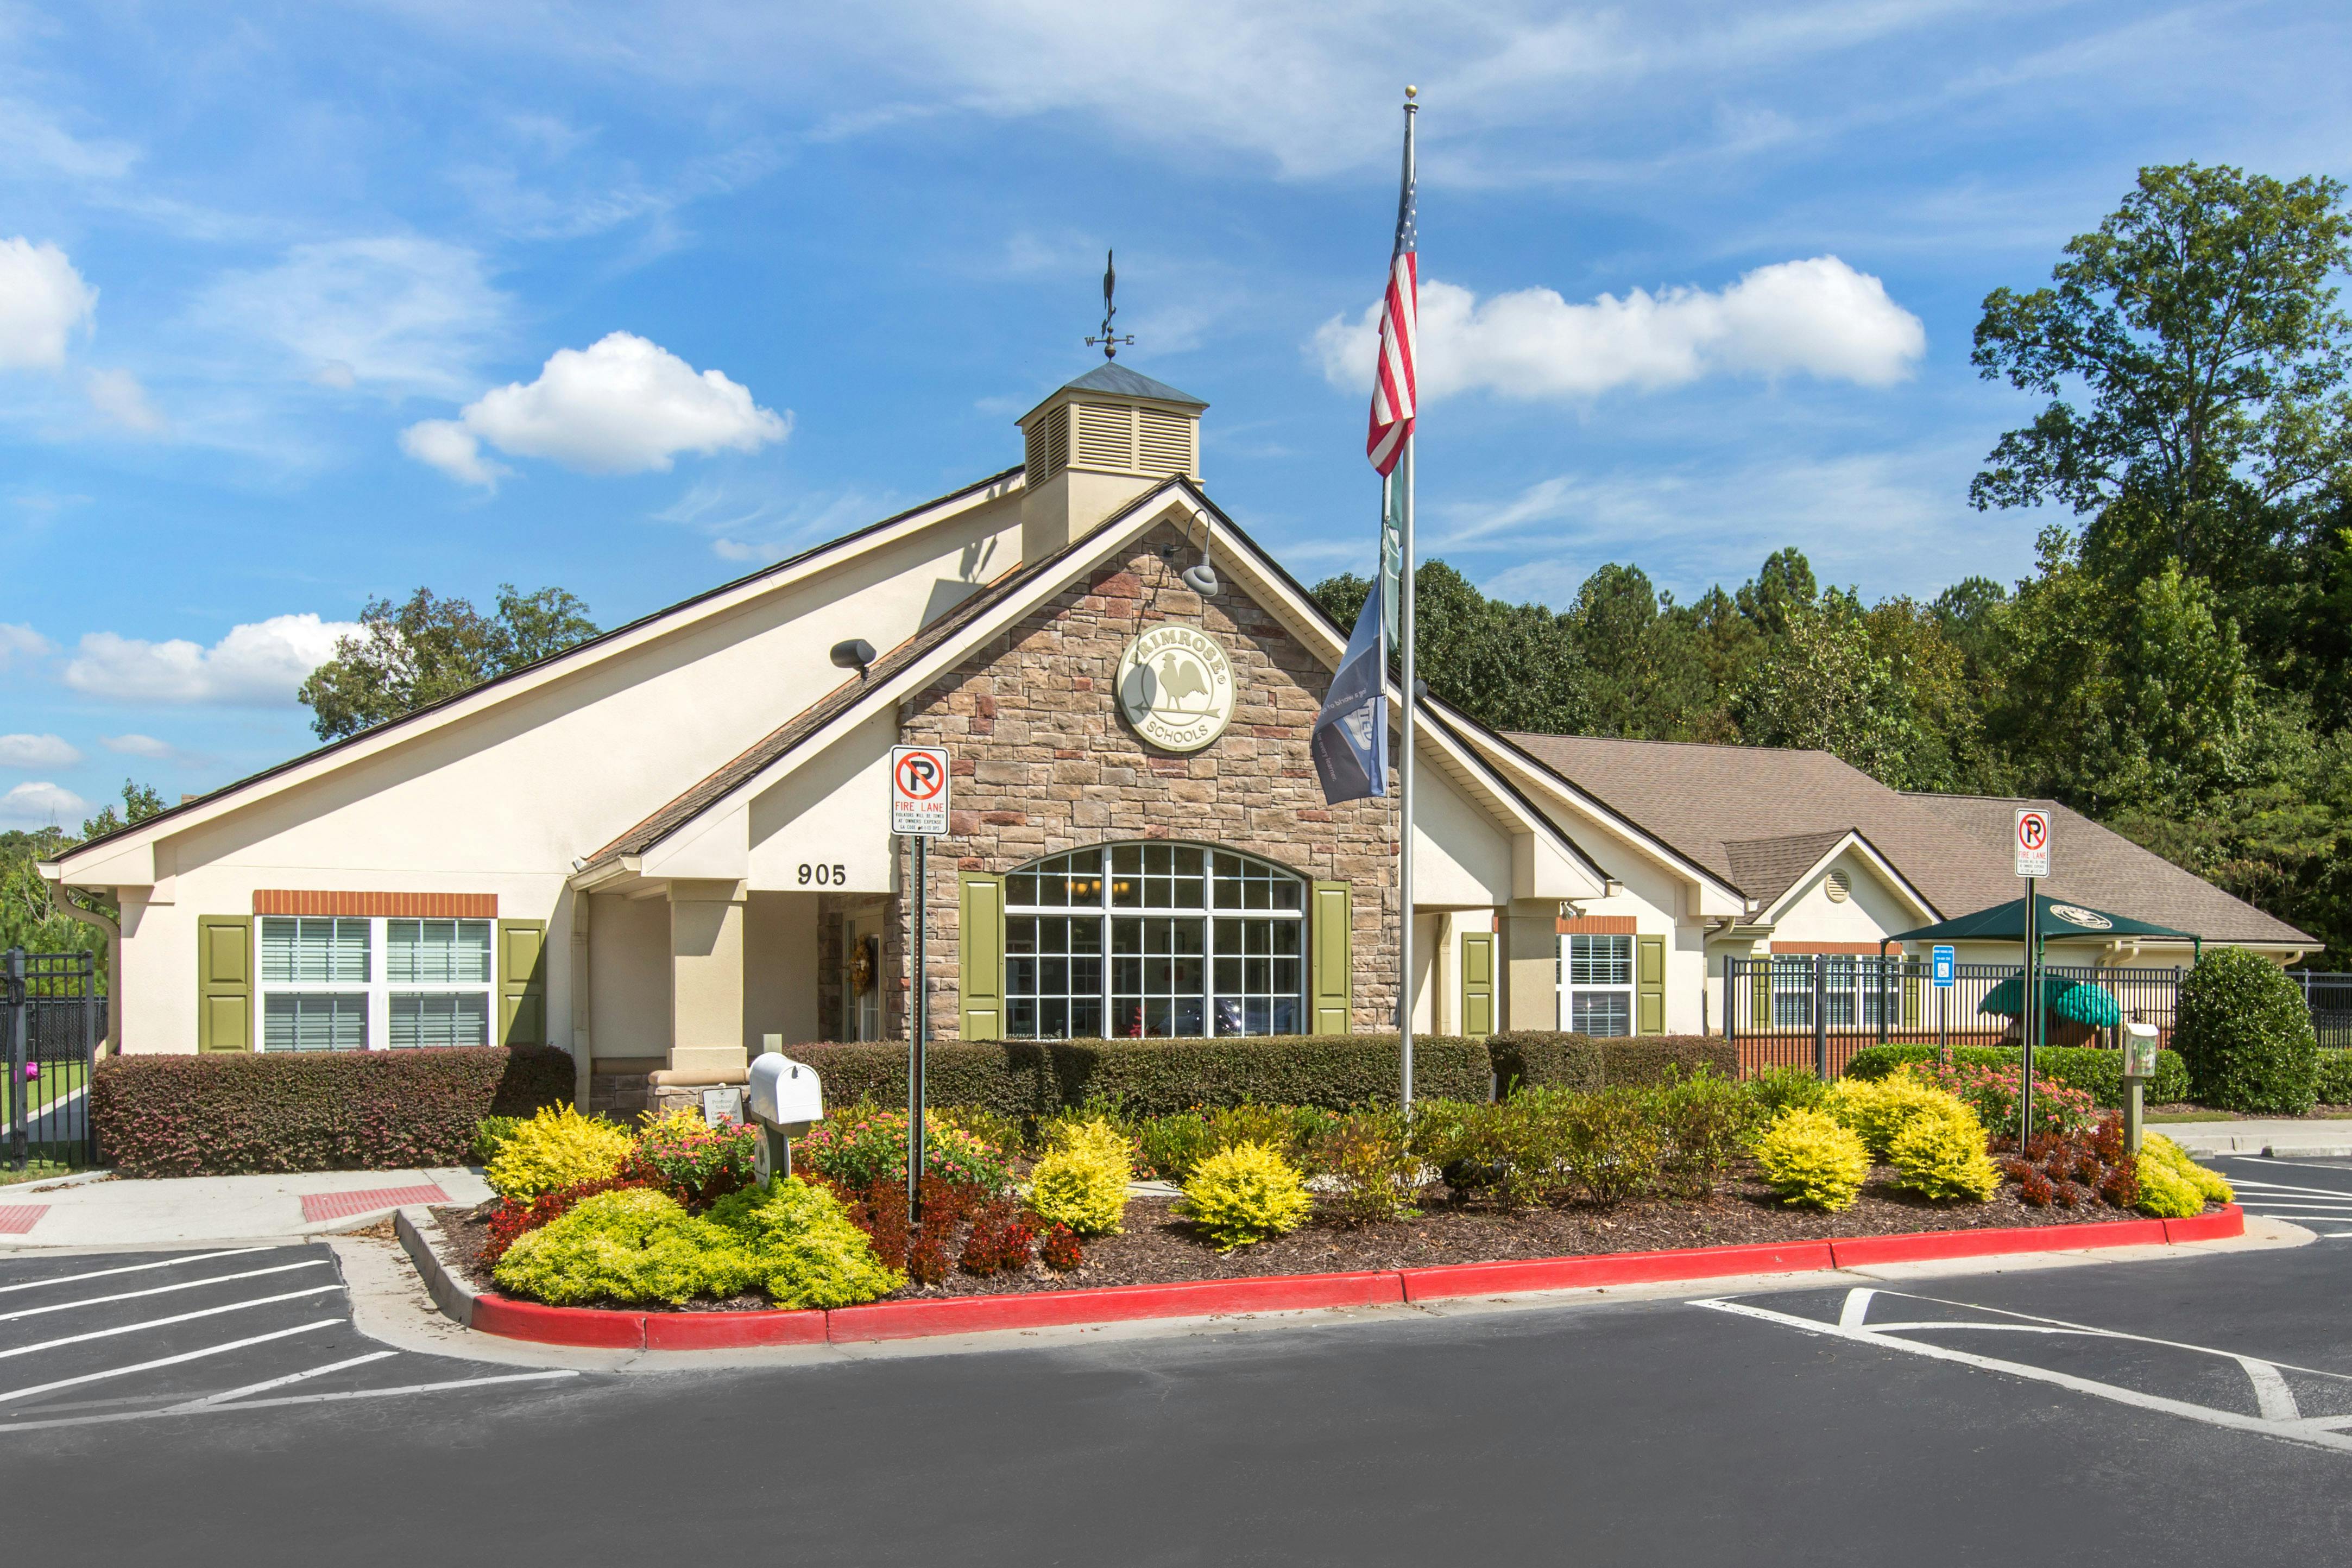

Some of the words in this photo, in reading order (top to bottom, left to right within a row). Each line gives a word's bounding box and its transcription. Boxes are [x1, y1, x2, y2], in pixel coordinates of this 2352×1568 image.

[1128, 629, 1225, 674] PRIMROSE
[1146, 720, 1208, 743] SCHOOLS
[1319, 742, 1328, 757] every
[895, 801, 915, 811] FIRE
[921, 802, 944, 812] LANE
[798, 863, 846, 886] 905
